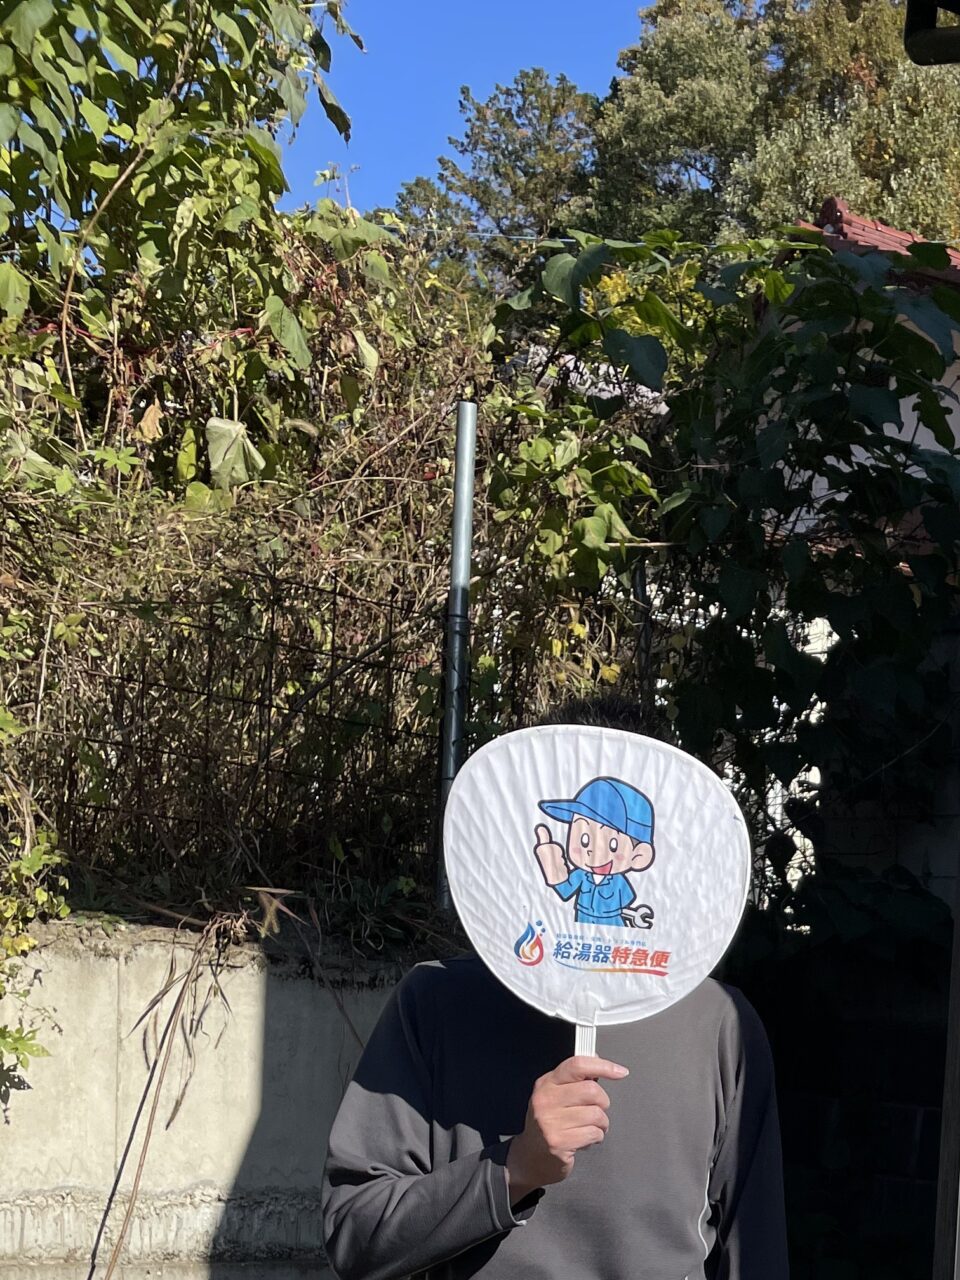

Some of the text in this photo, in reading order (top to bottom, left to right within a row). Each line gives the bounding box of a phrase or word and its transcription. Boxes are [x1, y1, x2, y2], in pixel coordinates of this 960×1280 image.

[553, 941, 672, 968] 給湯器特急便
